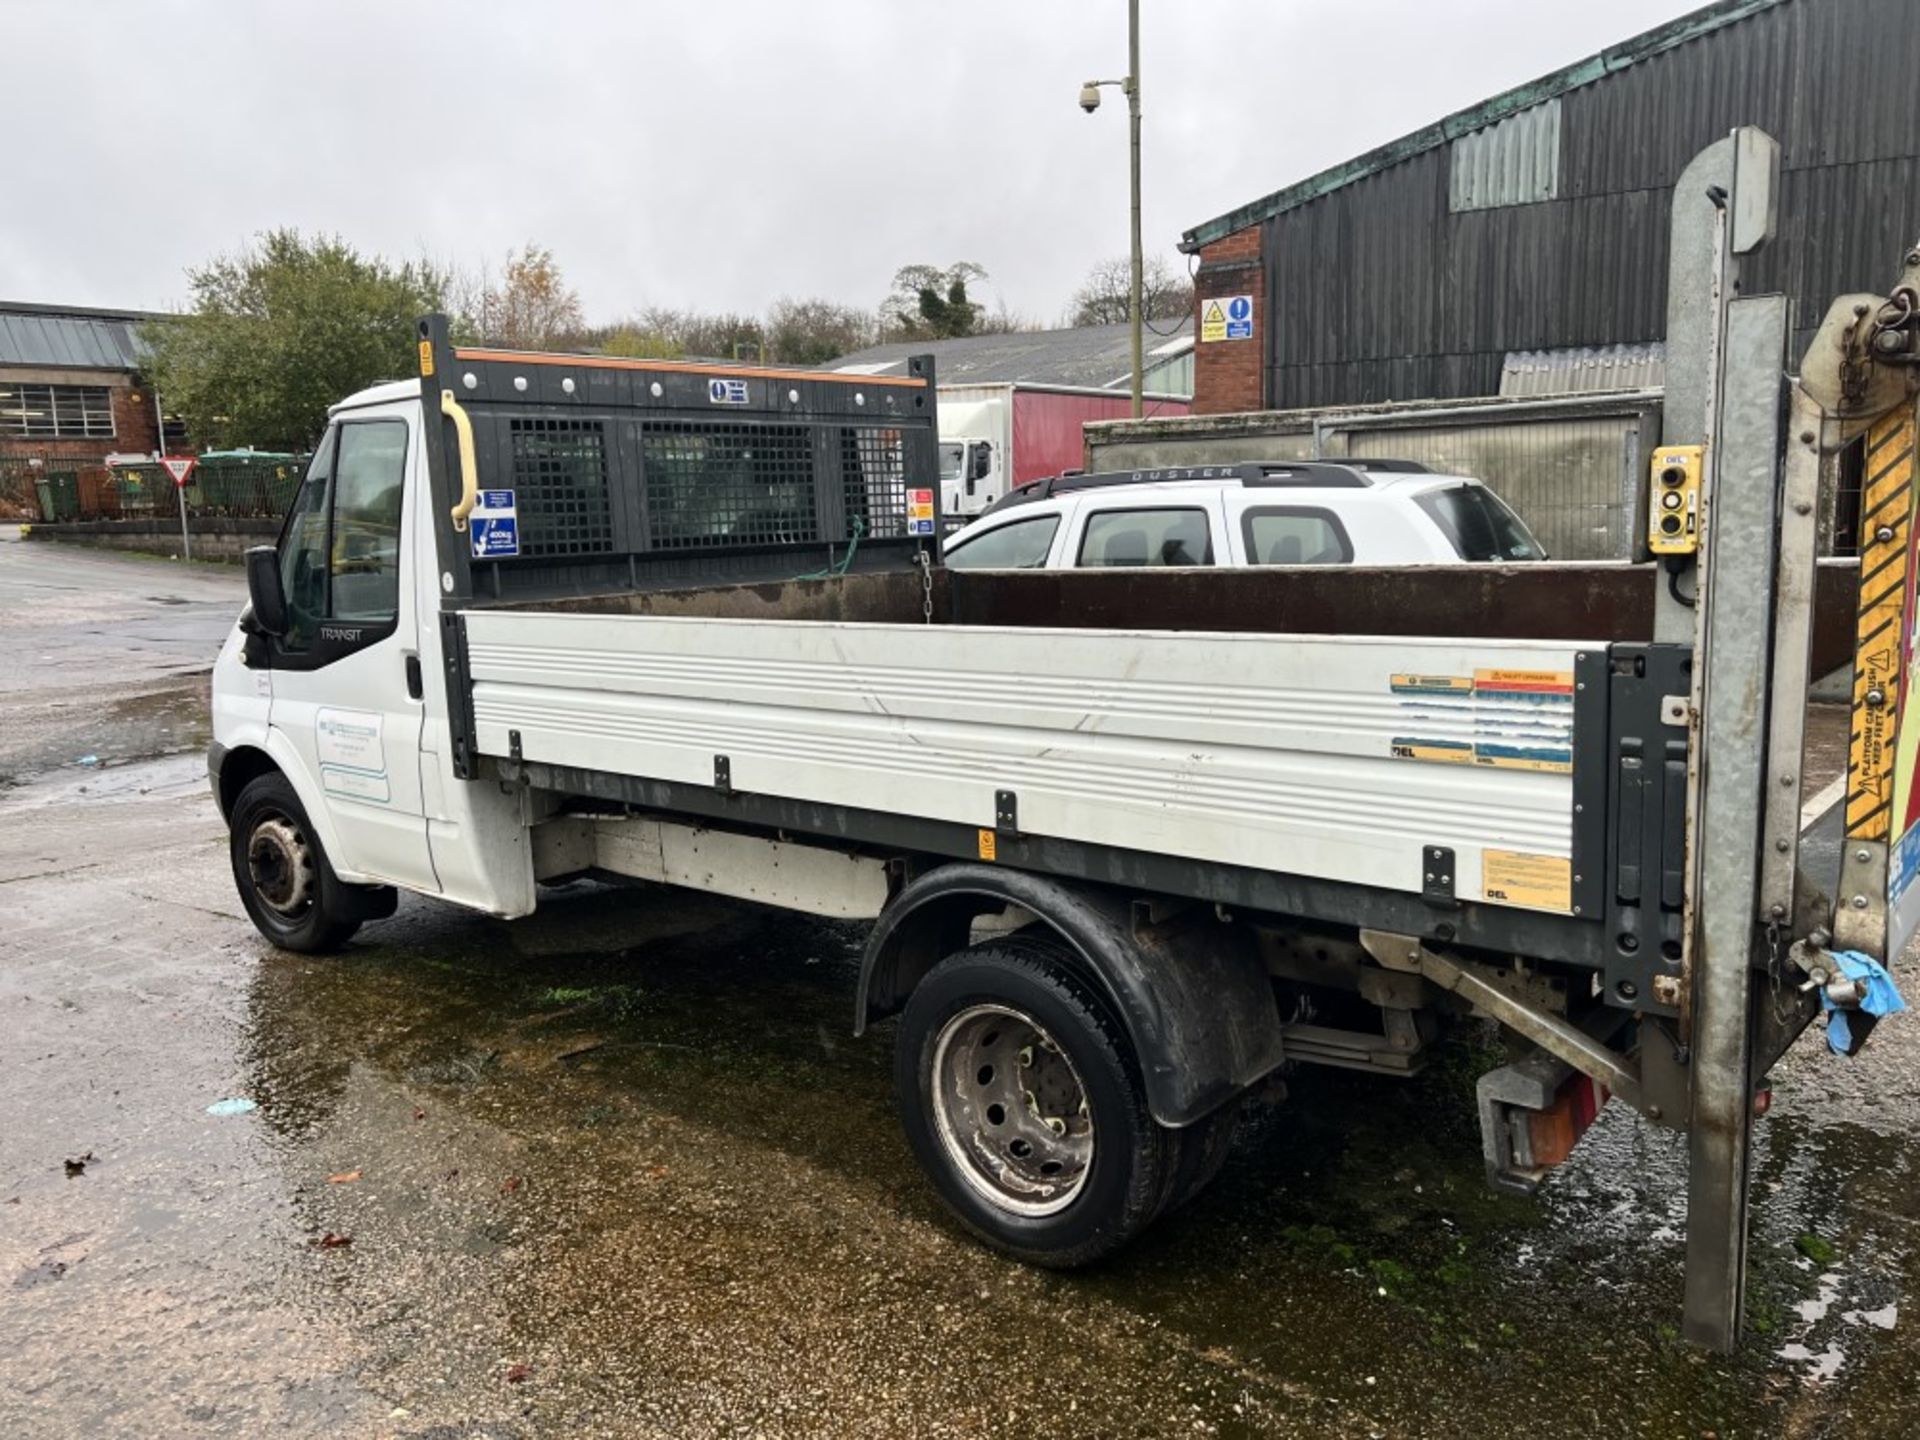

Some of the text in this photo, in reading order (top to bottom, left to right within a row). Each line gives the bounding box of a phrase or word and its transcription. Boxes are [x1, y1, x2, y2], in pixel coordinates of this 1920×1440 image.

[1132, 468, 1233, 481] DUSTER
[320, 627, 362, 642] TRANSIT
[1874, 715, 1884, 738] FEET
[1861, 727, 1874, 777] PLATFORM
[1872, 740, 1883, 765] KEEP
[1487, 889, 1508, 900] DEL
